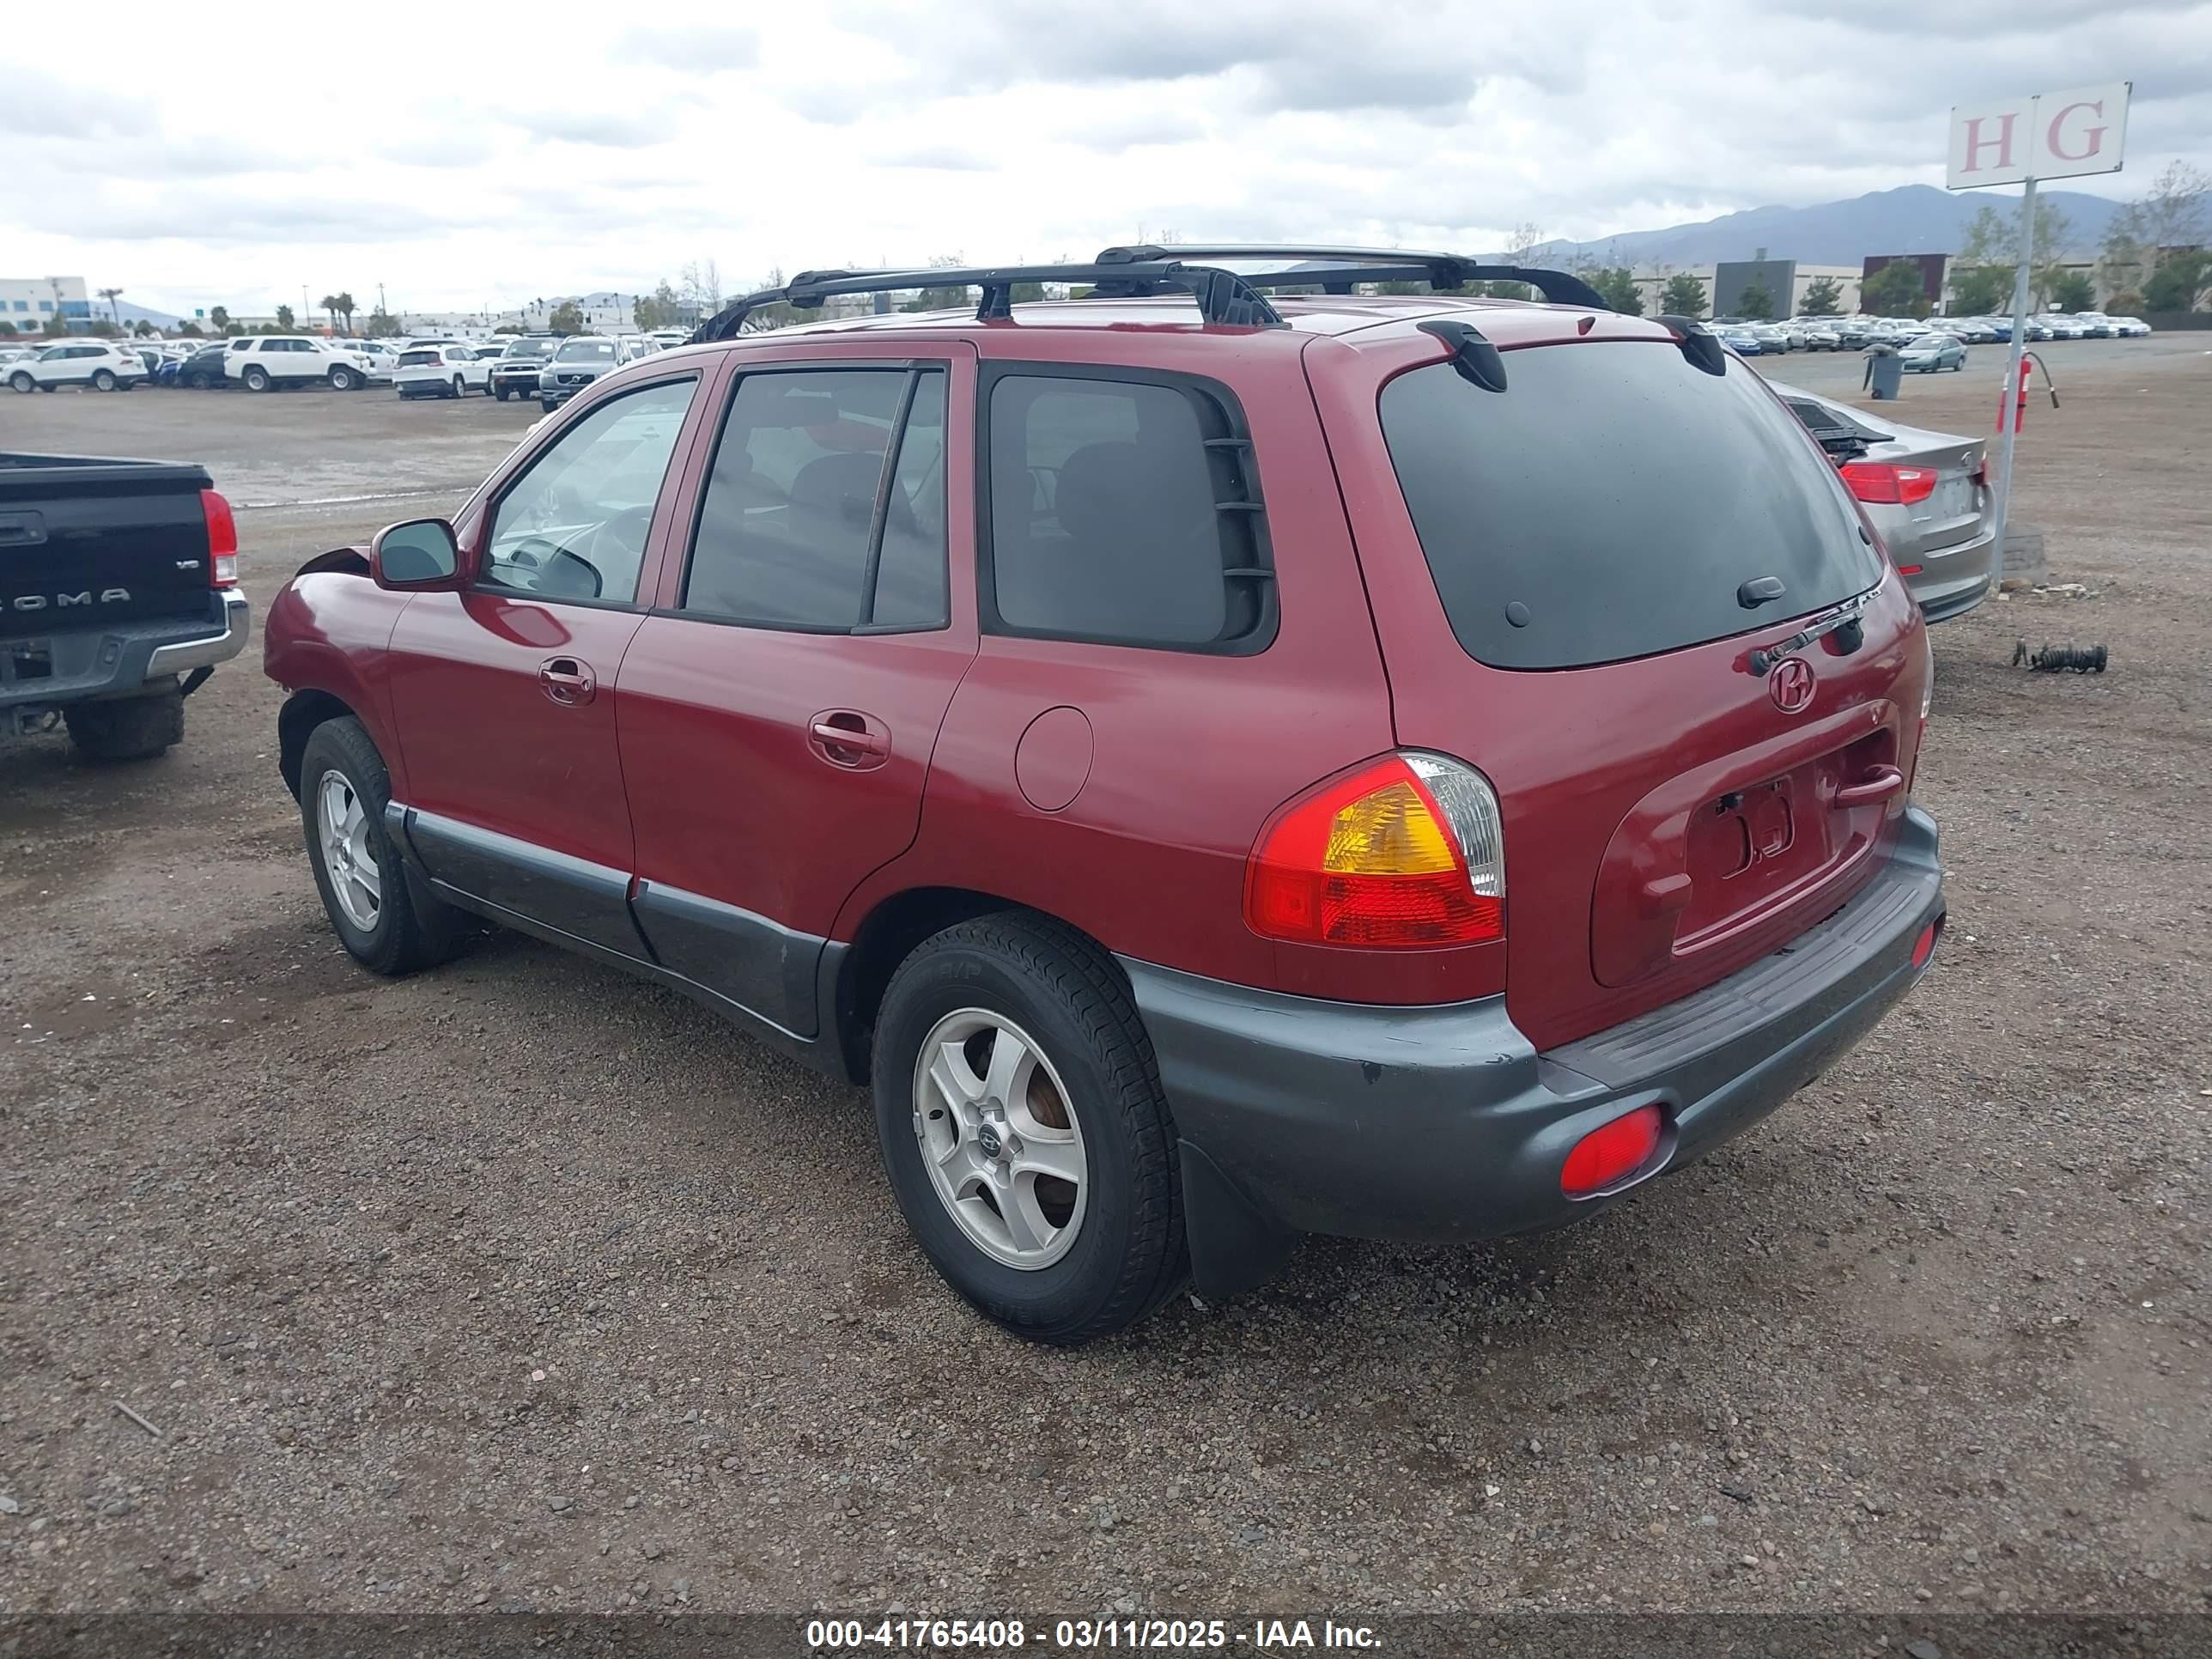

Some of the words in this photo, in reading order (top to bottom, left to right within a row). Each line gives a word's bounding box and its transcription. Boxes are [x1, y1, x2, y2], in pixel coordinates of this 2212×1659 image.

[1960, 112, 2020, 173] H
[2047, 100, 2109, 161] G
[0, 588, 131, 611] OMA
